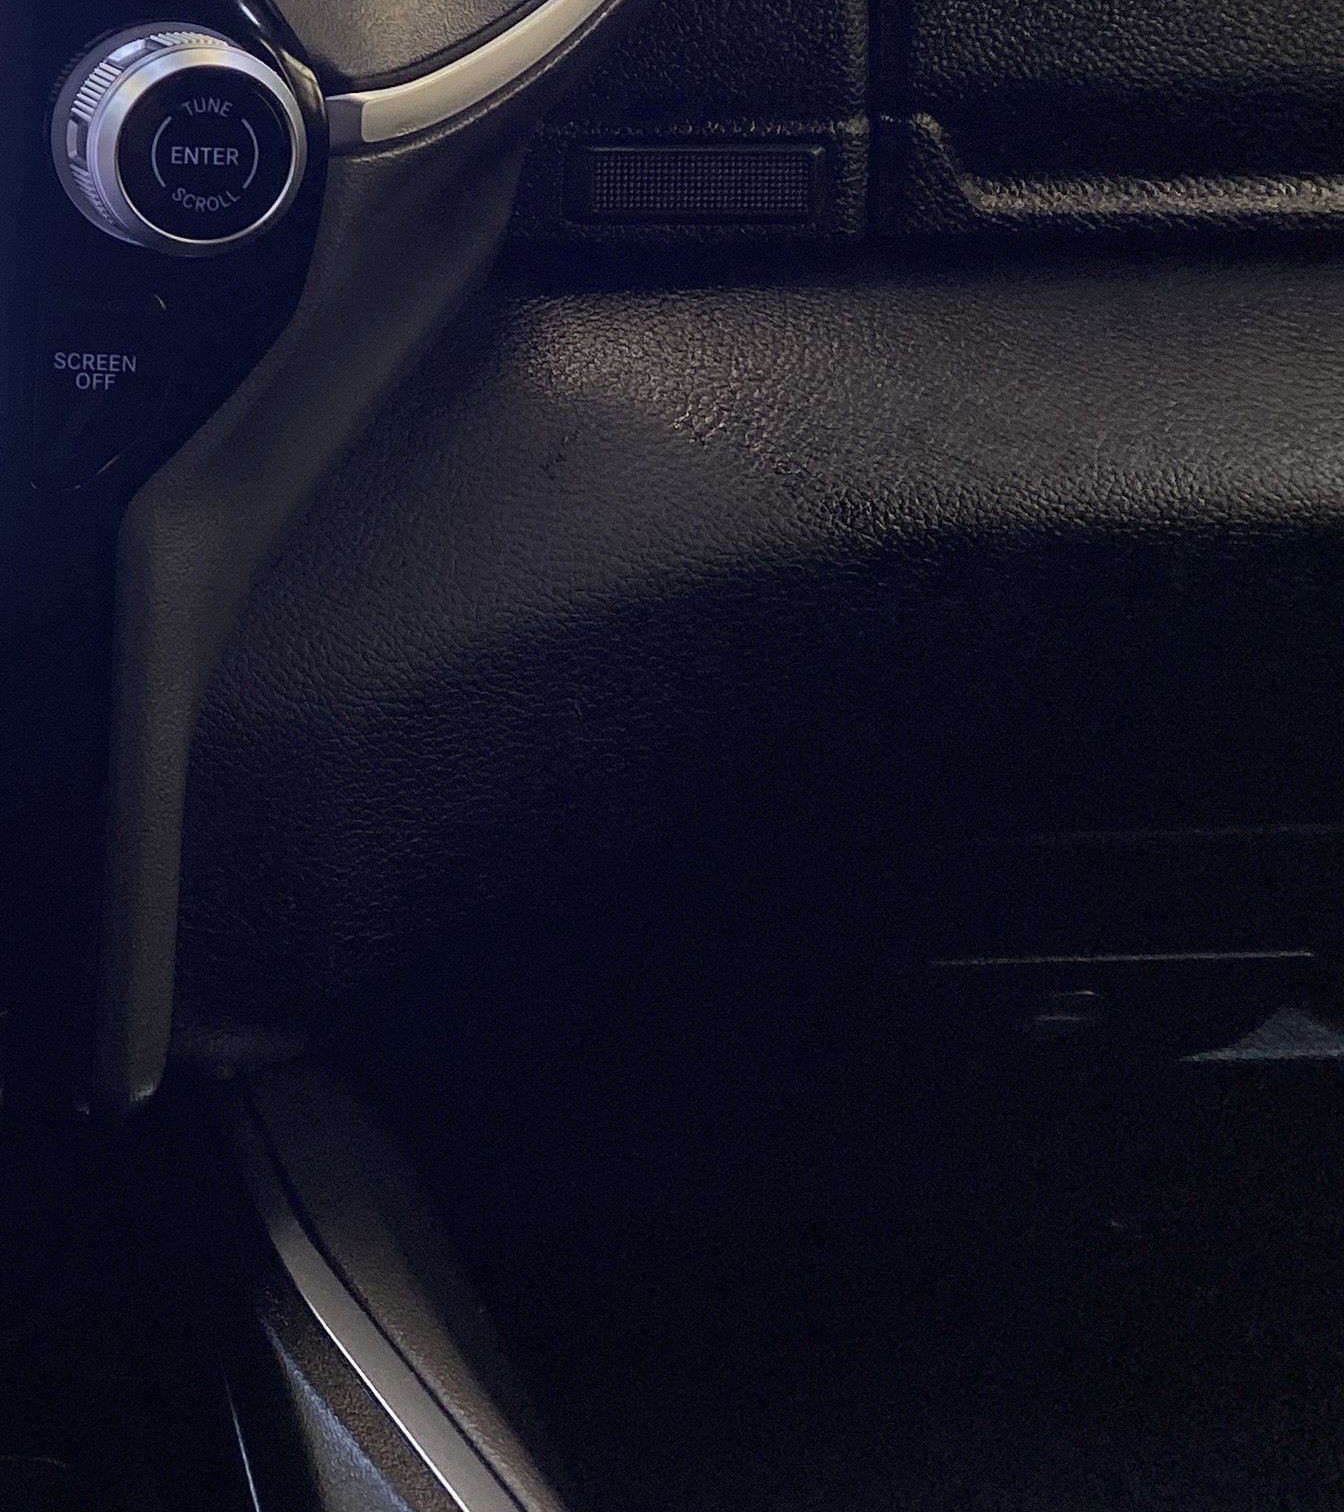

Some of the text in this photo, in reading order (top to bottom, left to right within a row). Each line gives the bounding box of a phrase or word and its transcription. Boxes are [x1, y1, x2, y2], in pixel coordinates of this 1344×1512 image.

[182, 98, 232, 118] TUNE
[171, 146, 239, 166] ENTER
[172, 187, 241, 212] SCROLL
[54, 352, 137, 372] SCREEN
[76, 373, 116, 390] OFF
